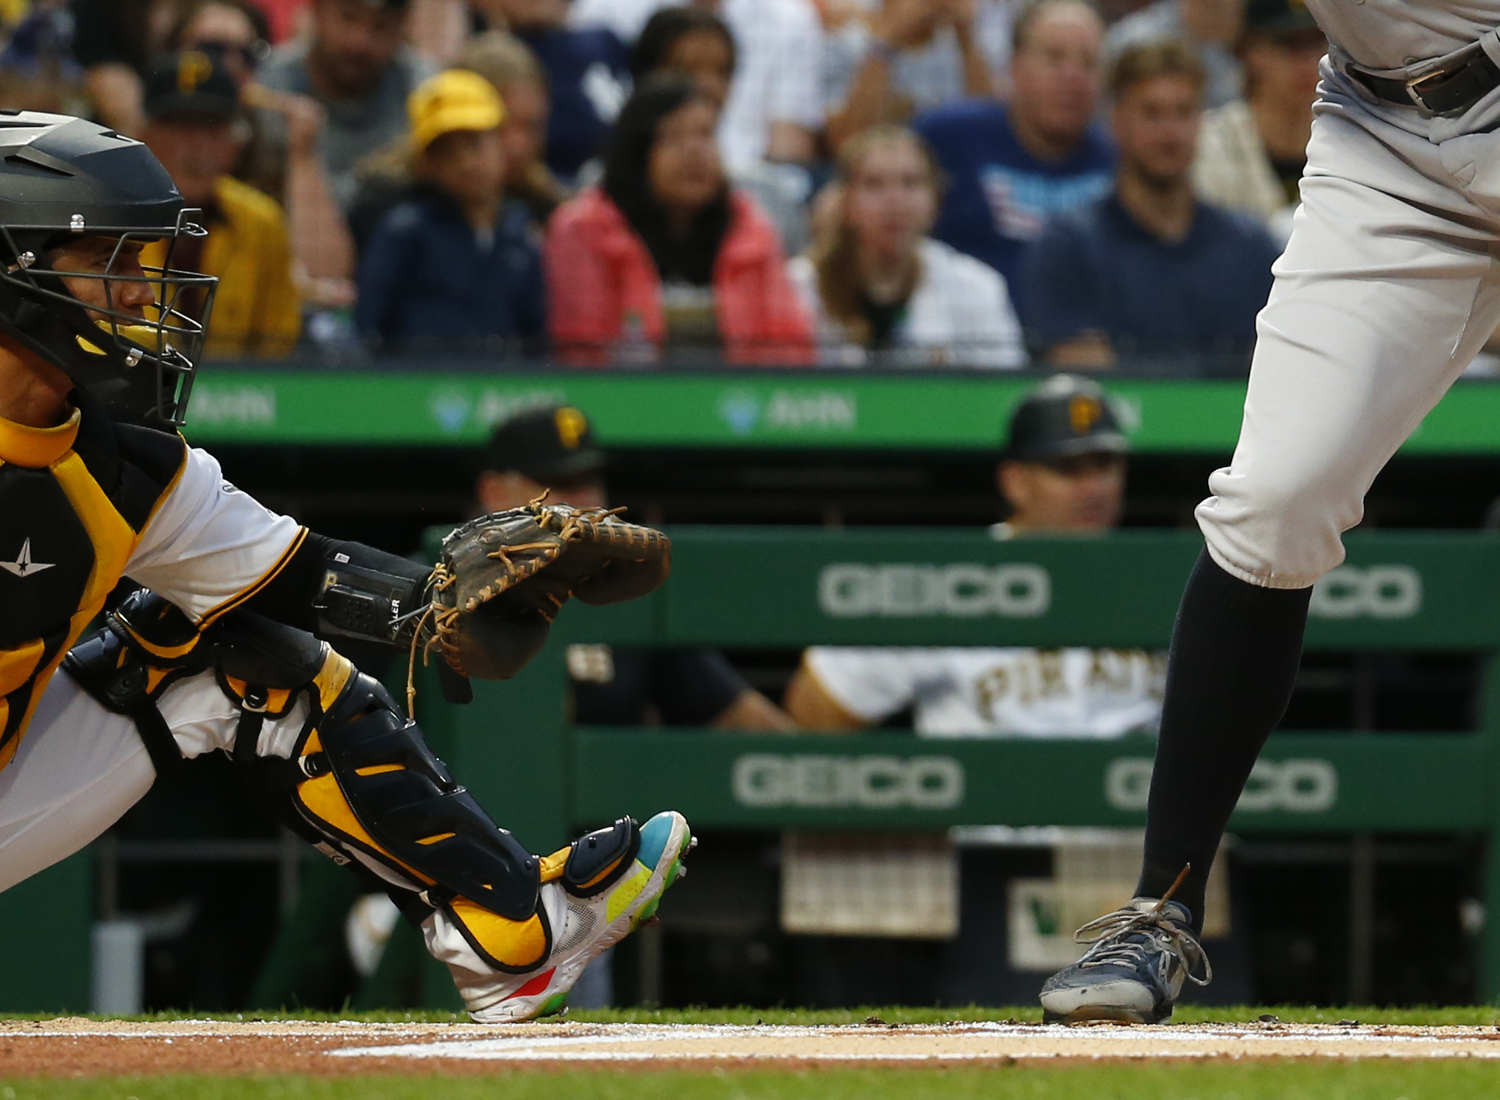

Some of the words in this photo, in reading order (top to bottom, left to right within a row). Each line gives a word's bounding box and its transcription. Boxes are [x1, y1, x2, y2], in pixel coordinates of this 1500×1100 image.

[554, 406, 588, 450] P
[391, 598, 401, 633] ELER
[818, 564, 1051, 618] GEICO
[732, 756, 964, 809] GEICO
[1106, 757, 1338, 811] GCO
